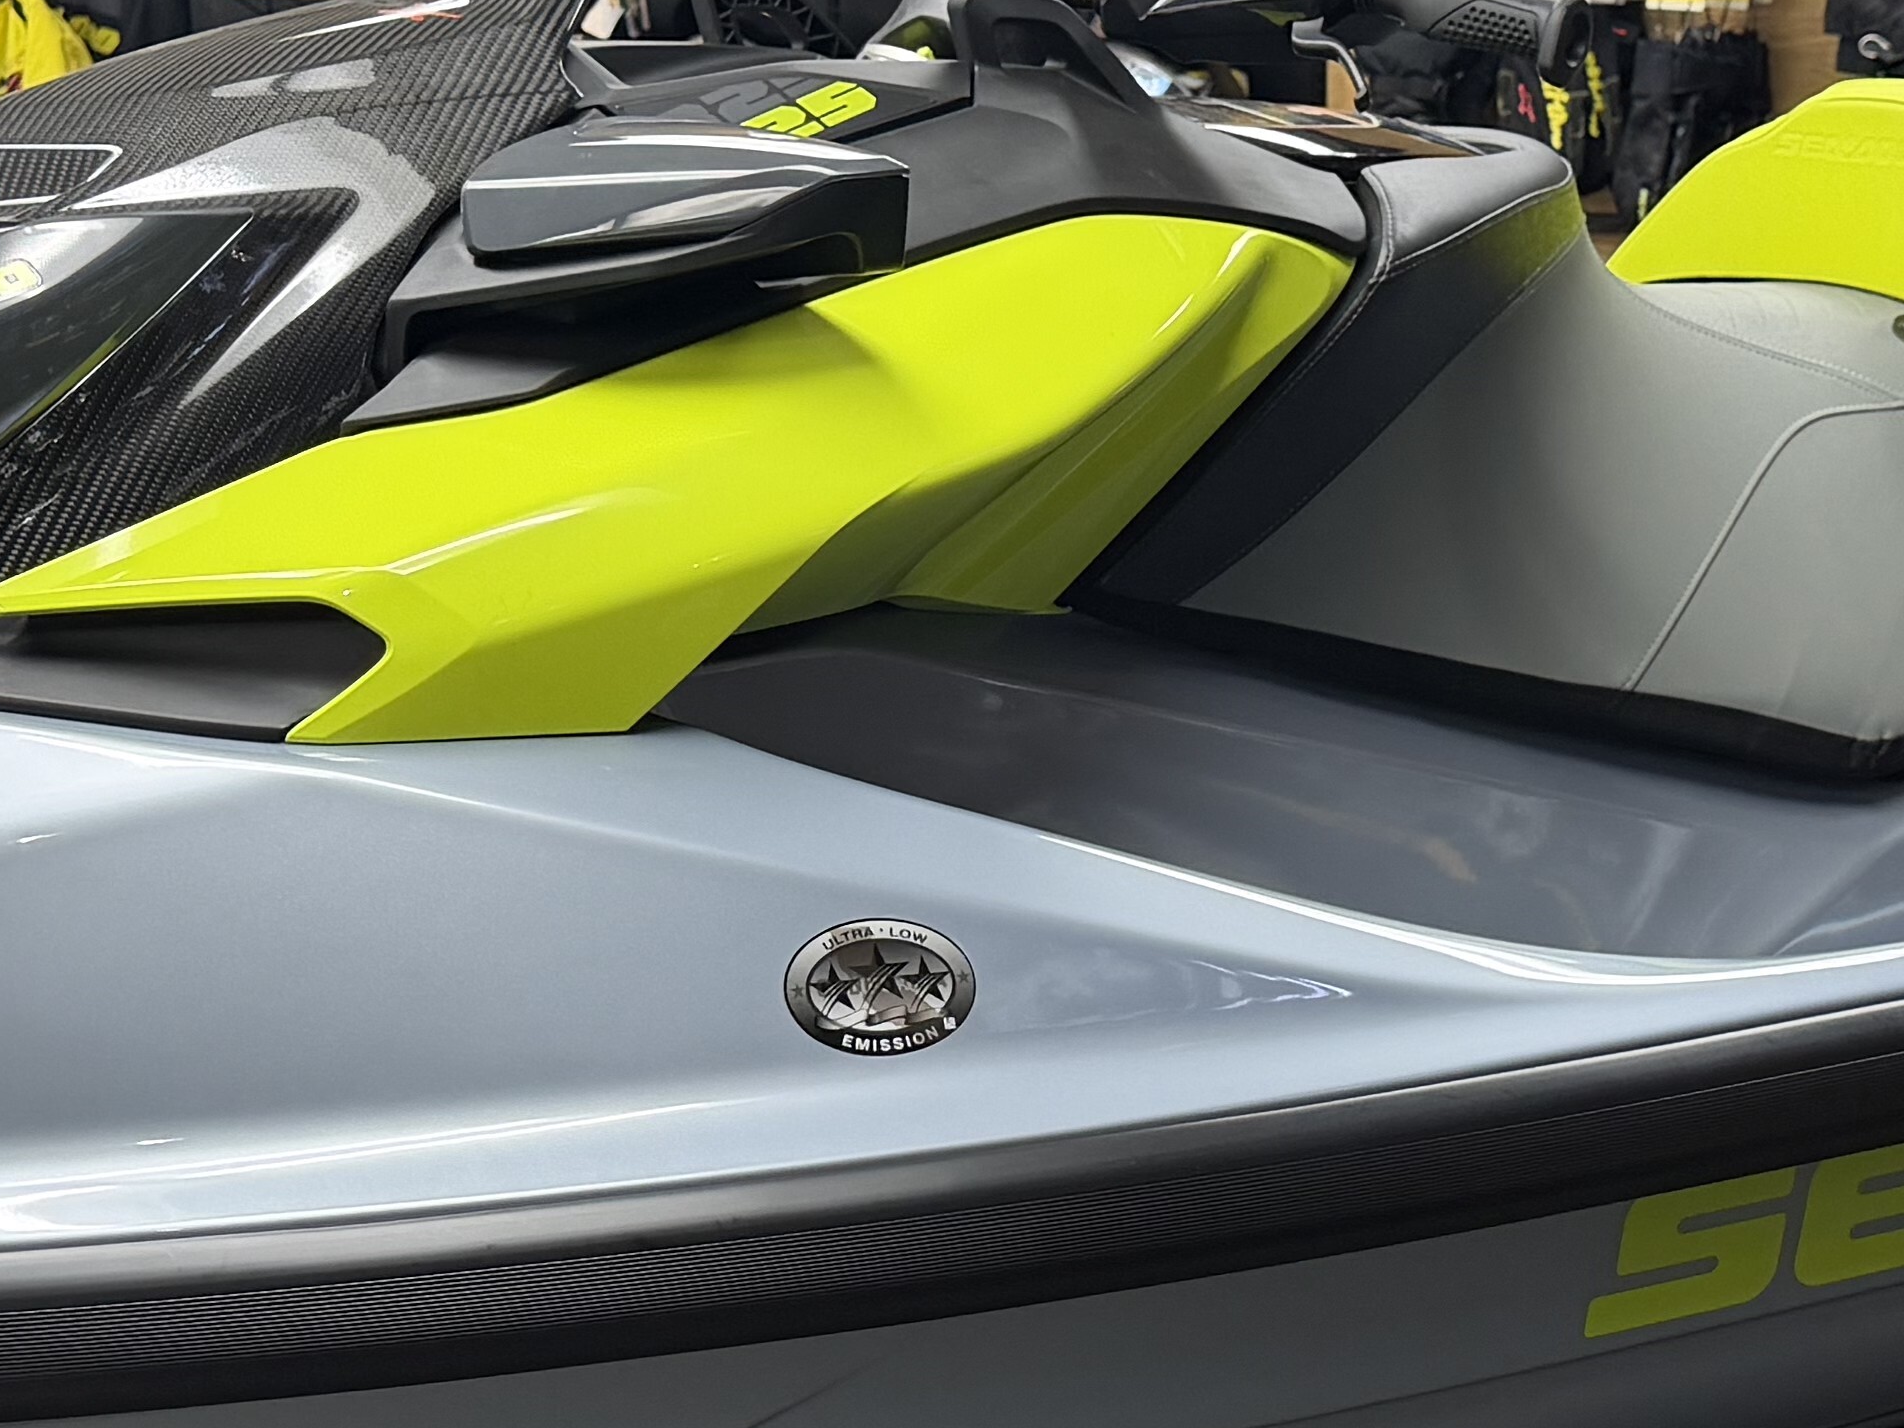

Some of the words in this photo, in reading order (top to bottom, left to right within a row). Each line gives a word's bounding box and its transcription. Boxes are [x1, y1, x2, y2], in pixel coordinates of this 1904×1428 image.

[821, 926, 875, 951] ULTRA
[889, 926, 929, 944] LOW
[841, 1025, 940, 1053] EMISSION
